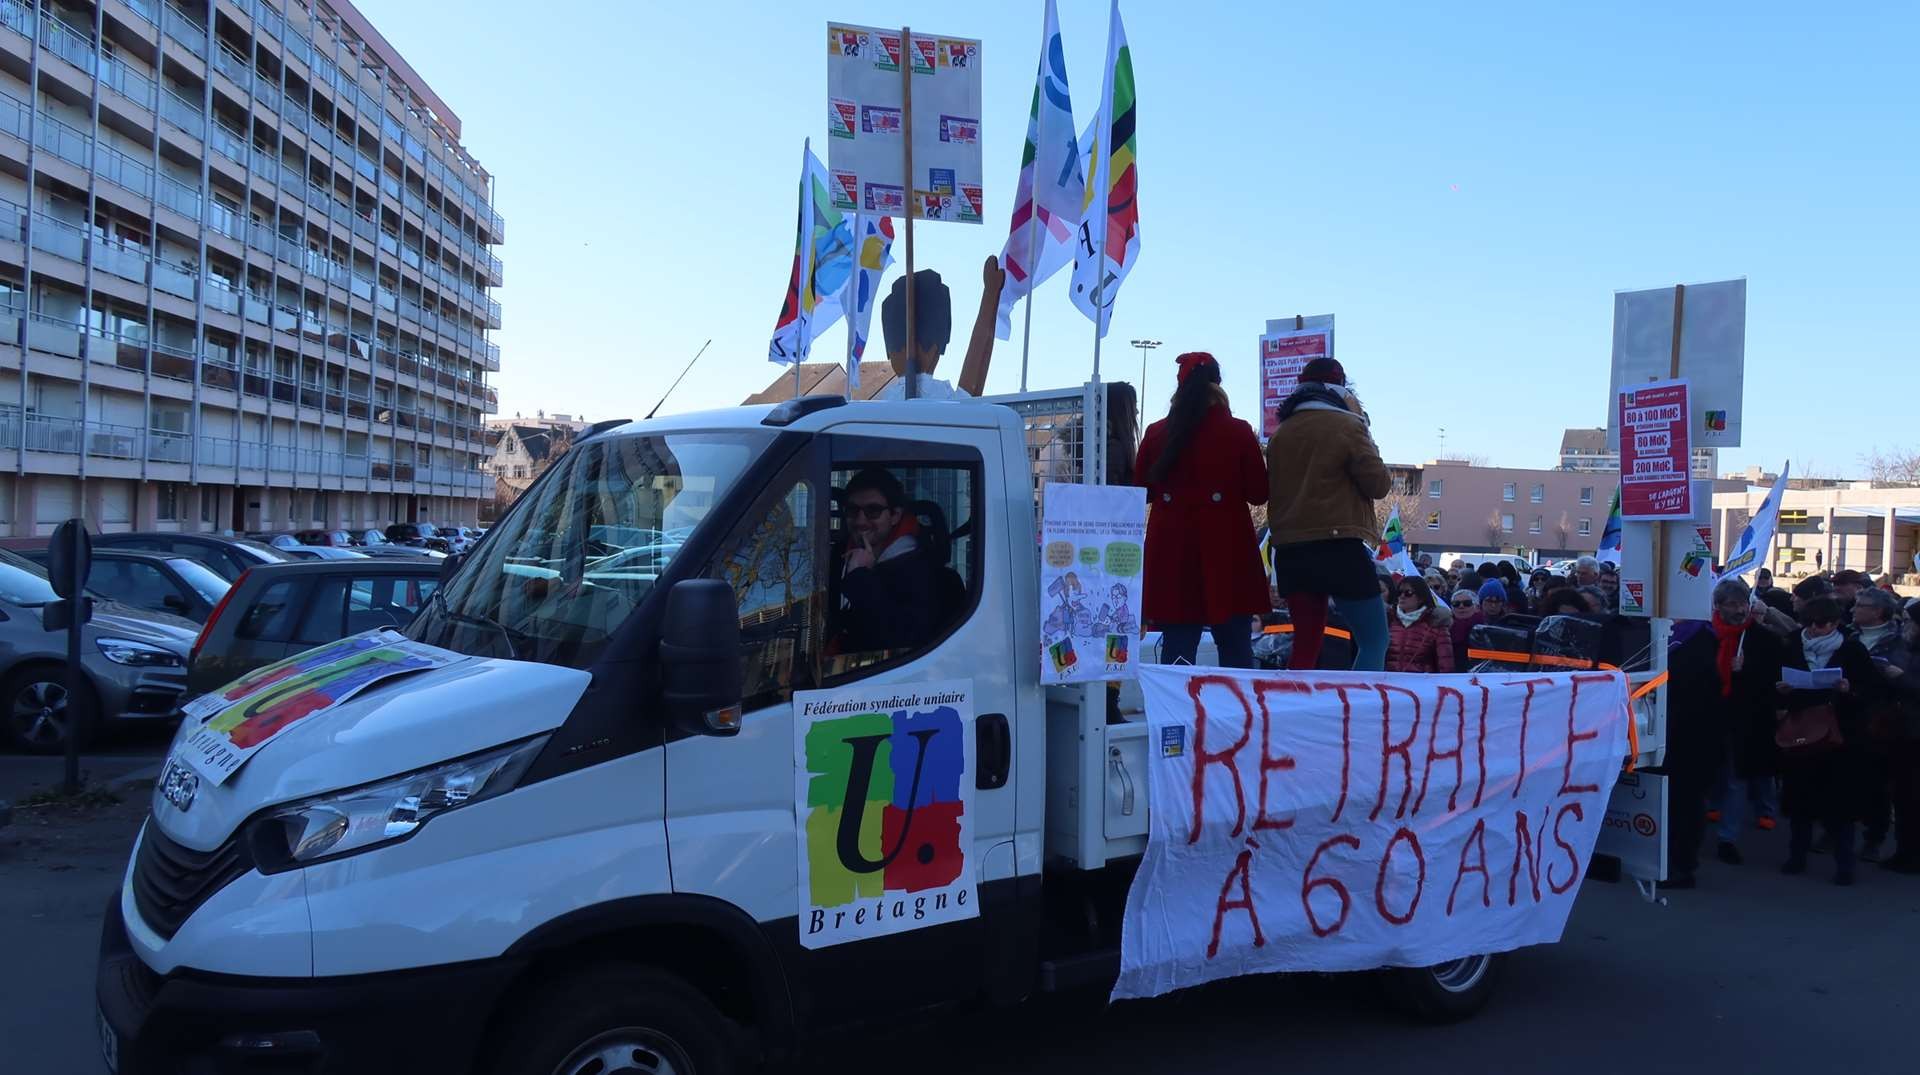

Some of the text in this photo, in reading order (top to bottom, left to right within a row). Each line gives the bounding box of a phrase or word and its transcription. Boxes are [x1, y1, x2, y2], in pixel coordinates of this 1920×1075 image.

[1645, 408, 1659, 421] 100
[1635, 461, 1651, 474] 200
[803, 691, 966, 716] Fédération syndicale unitaire
[1206, 802, 1585, 960] À 60 ANS
[807, 887, 969, 936] Bretagne
